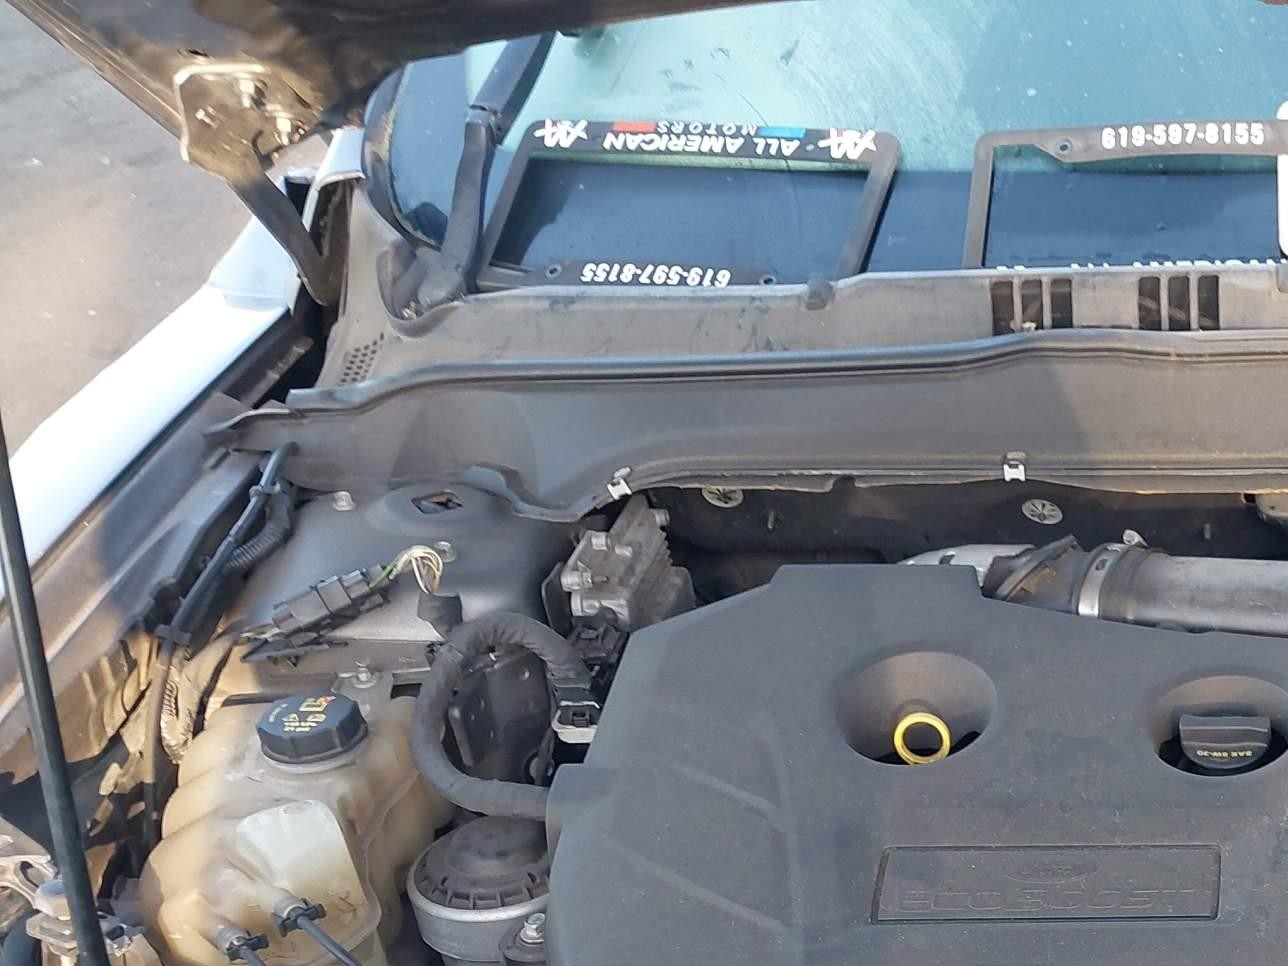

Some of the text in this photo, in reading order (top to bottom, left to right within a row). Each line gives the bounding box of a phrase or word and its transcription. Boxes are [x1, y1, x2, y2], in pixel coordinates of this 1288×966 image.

[656, 119, 758, 137] MOTORS
[1101, 122, 1265, 150] 619-597-8155
[602, 132, 801, 157] ALL AMERICAN
[579, 262, 732, 289] 619-597-8155
